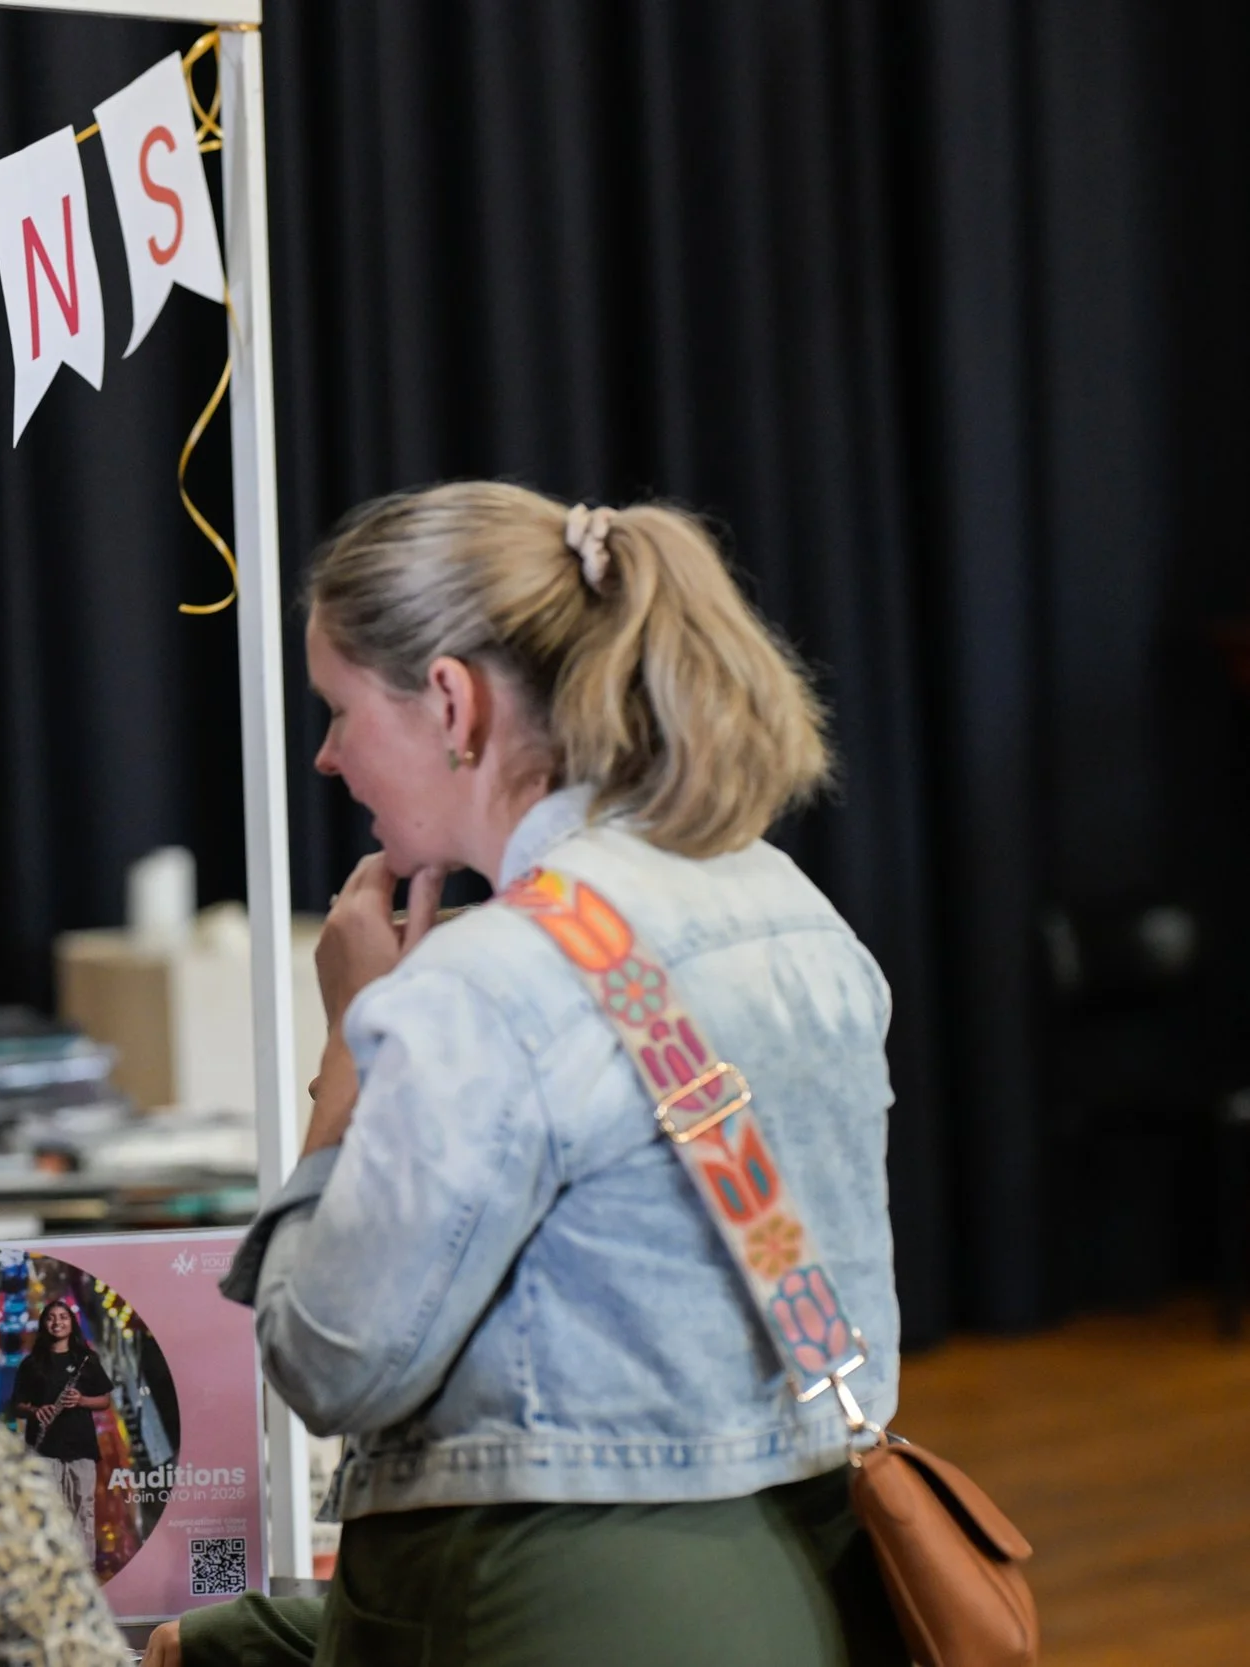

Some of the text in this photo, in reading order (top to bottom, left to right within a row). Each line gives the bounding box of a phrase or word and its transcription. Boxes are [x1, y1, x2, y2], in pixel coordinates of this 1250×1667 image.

[108, 1462, 246, 1489] Auditions
[124, 1487, 246, 1504] Join QYO in 2026
